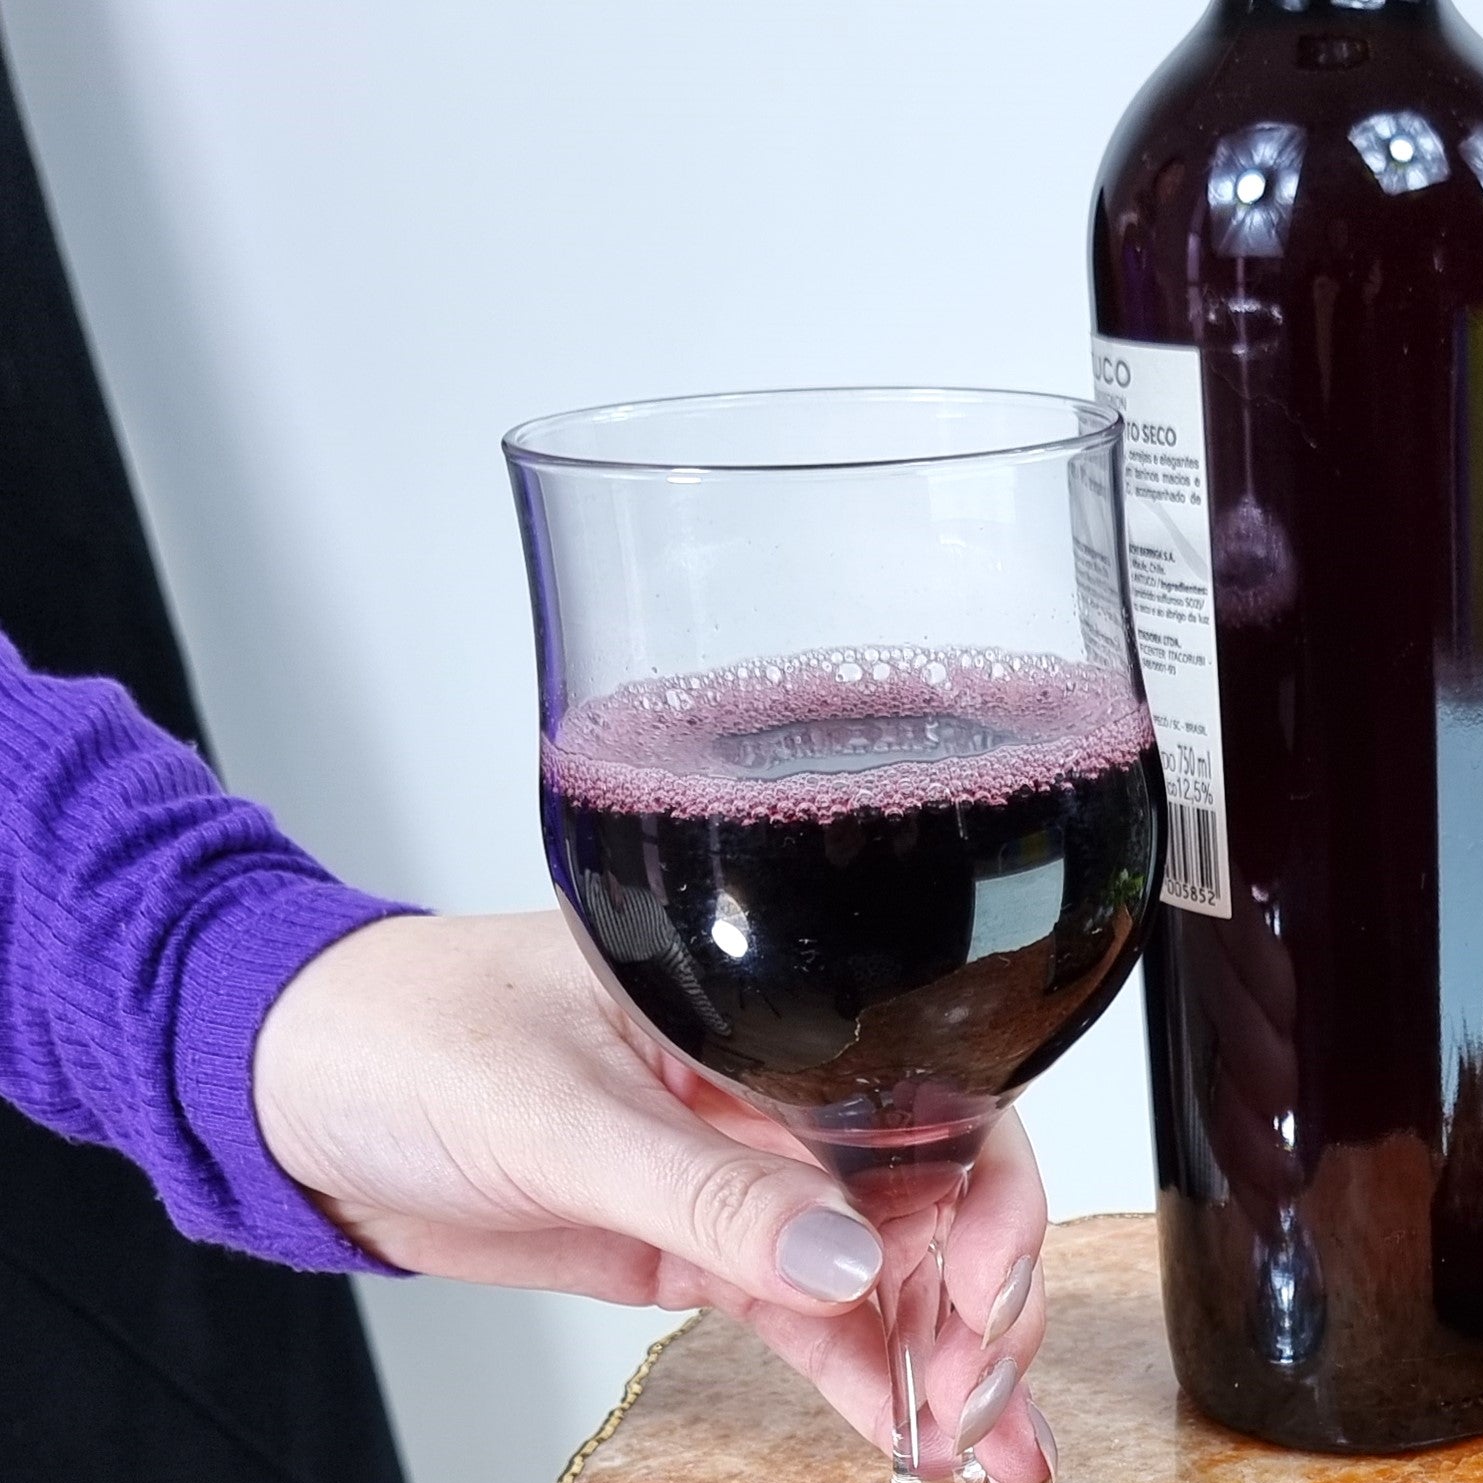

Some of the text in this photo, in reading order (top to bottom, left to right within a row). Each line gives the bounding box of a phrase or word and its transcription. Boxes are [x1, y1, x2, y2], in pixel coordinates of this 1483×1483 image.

[1091, 353, 1131, 389] UCO
[1142, 424, 1178, 447] SECO
[1160, 453, 1200, 471] elegantes
[1162, 473, 1191, 487] macios
[1194, 477, 1201, 488] e
[1135, 487, 1186, 503] acompanhado
[1190, 491, 1202, 506] de
[1177, 744, 1196, 777] 750
[1197, 750, 1212, 780] ml
[1177, 777, 1214, 805] 12,5%
